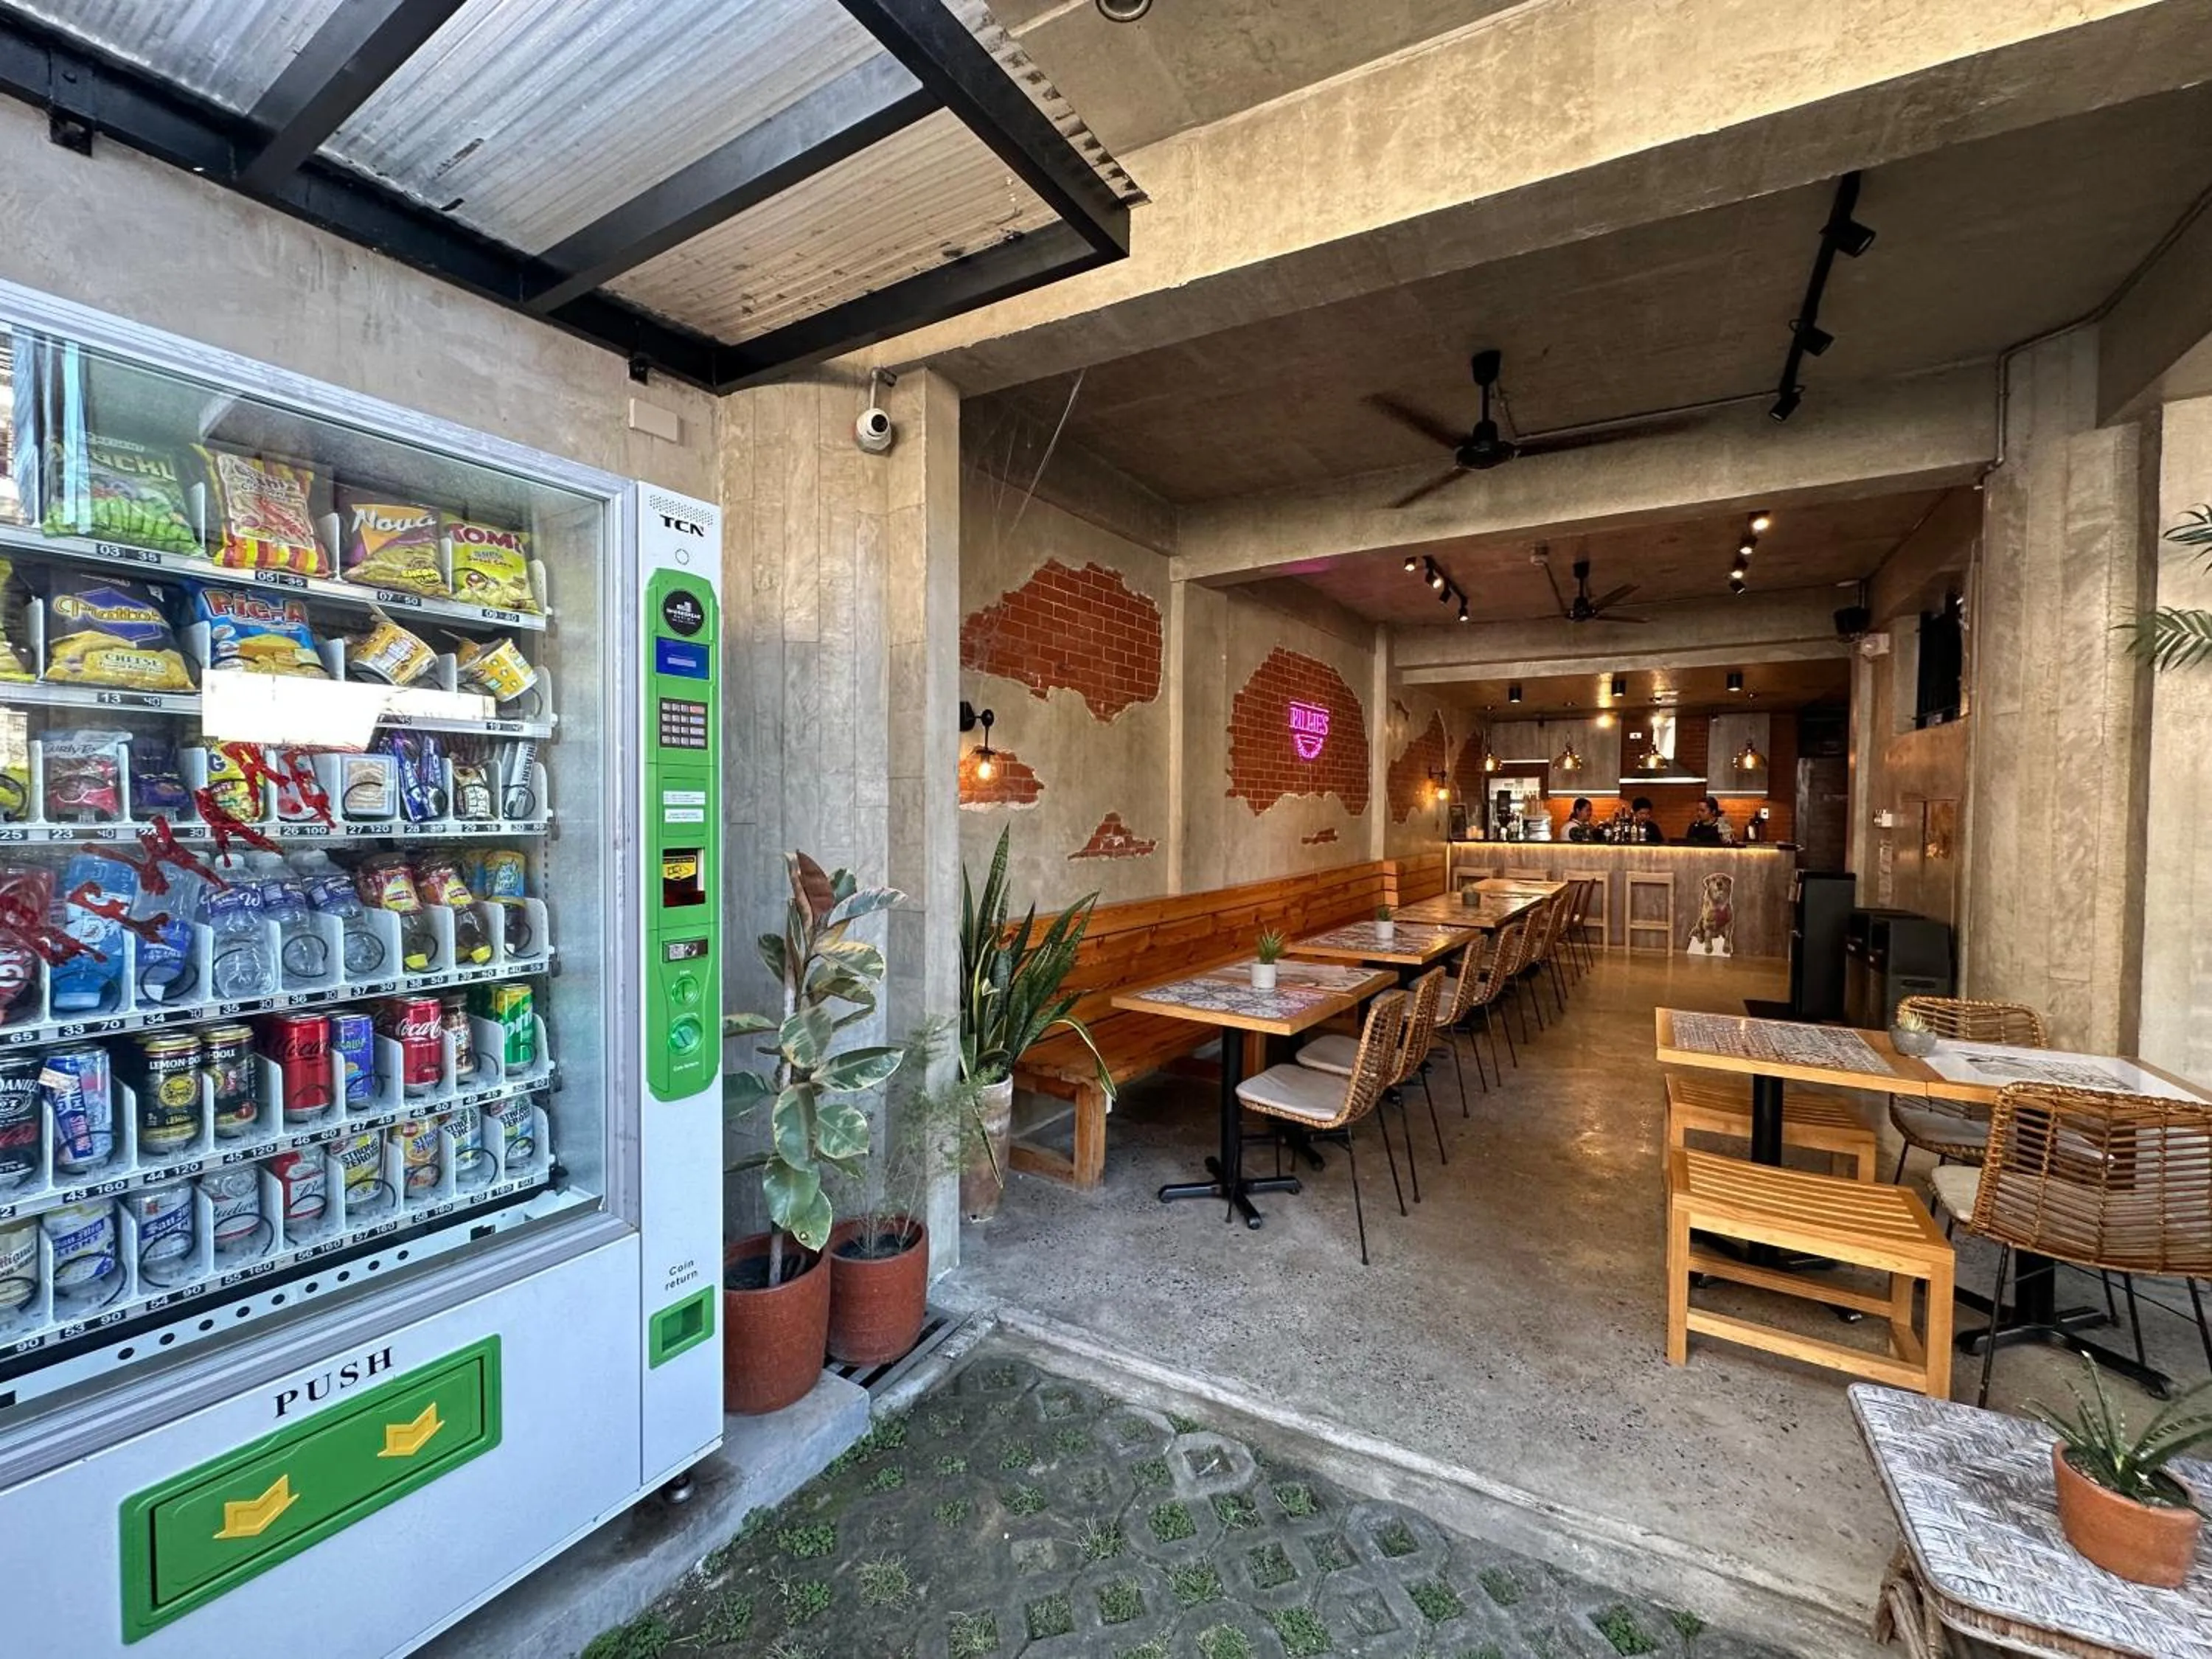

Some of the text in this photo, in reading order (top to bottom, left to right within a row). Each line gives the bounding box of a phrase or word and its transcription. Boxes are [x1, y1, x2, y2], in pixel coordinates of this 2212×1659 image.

[352, 508, 437, 533] Nova
[659, 515, 704, 537] TCN
[100, 545, 120, 557] 03
[257, 571, 274, 582] 05
[379, 591, 393, 601] 07
[104, 653, 161, 667] CHEESE
[102, 695, 121, 703] 13
[52, 830, 74, 838] 23
[282, 827, 327, 835] 26 100
[348, 824, 389, 834] 27 120
[406, 825, 420, 833] 28
[409, 979, 422, 987] 38
[353, 987, 368, 995] 37
[291, 995, 307, 1004] 36
[223, 1004, 240, 1013] 35
[147, 1014, 165, 1023] 34
[64, 1020, 120, 1036] 33 70
[10, 1032, 33, 1042] 65
[412, 1108, 426, 1116] 48
[352, 1116, 392, 1130] 47 45
[293, 1130, 337, 1146] 46 60
[225, 1146, 274, 1163] 45 120
[147, 1163, 199, 1180] 44 120
[65, 1181, 125, 1201] 43 160
[355, 1231, 369, 1241] 57
[57, 1234, 100, 1258] LIGHT
[297, 1250, 313, 1260] 56
[669, 1259, 695, 1276] Coin
[223, 1273, 242, 1284] 55
[664, 1270, 698, 1292] return
[147, 1286, 201, 1309] 54 90
[64, 1312, 122, 1338] 53 90
[16, 1338, 40, 1352] 90
[273, 1346, 394, 1419] PUSH
